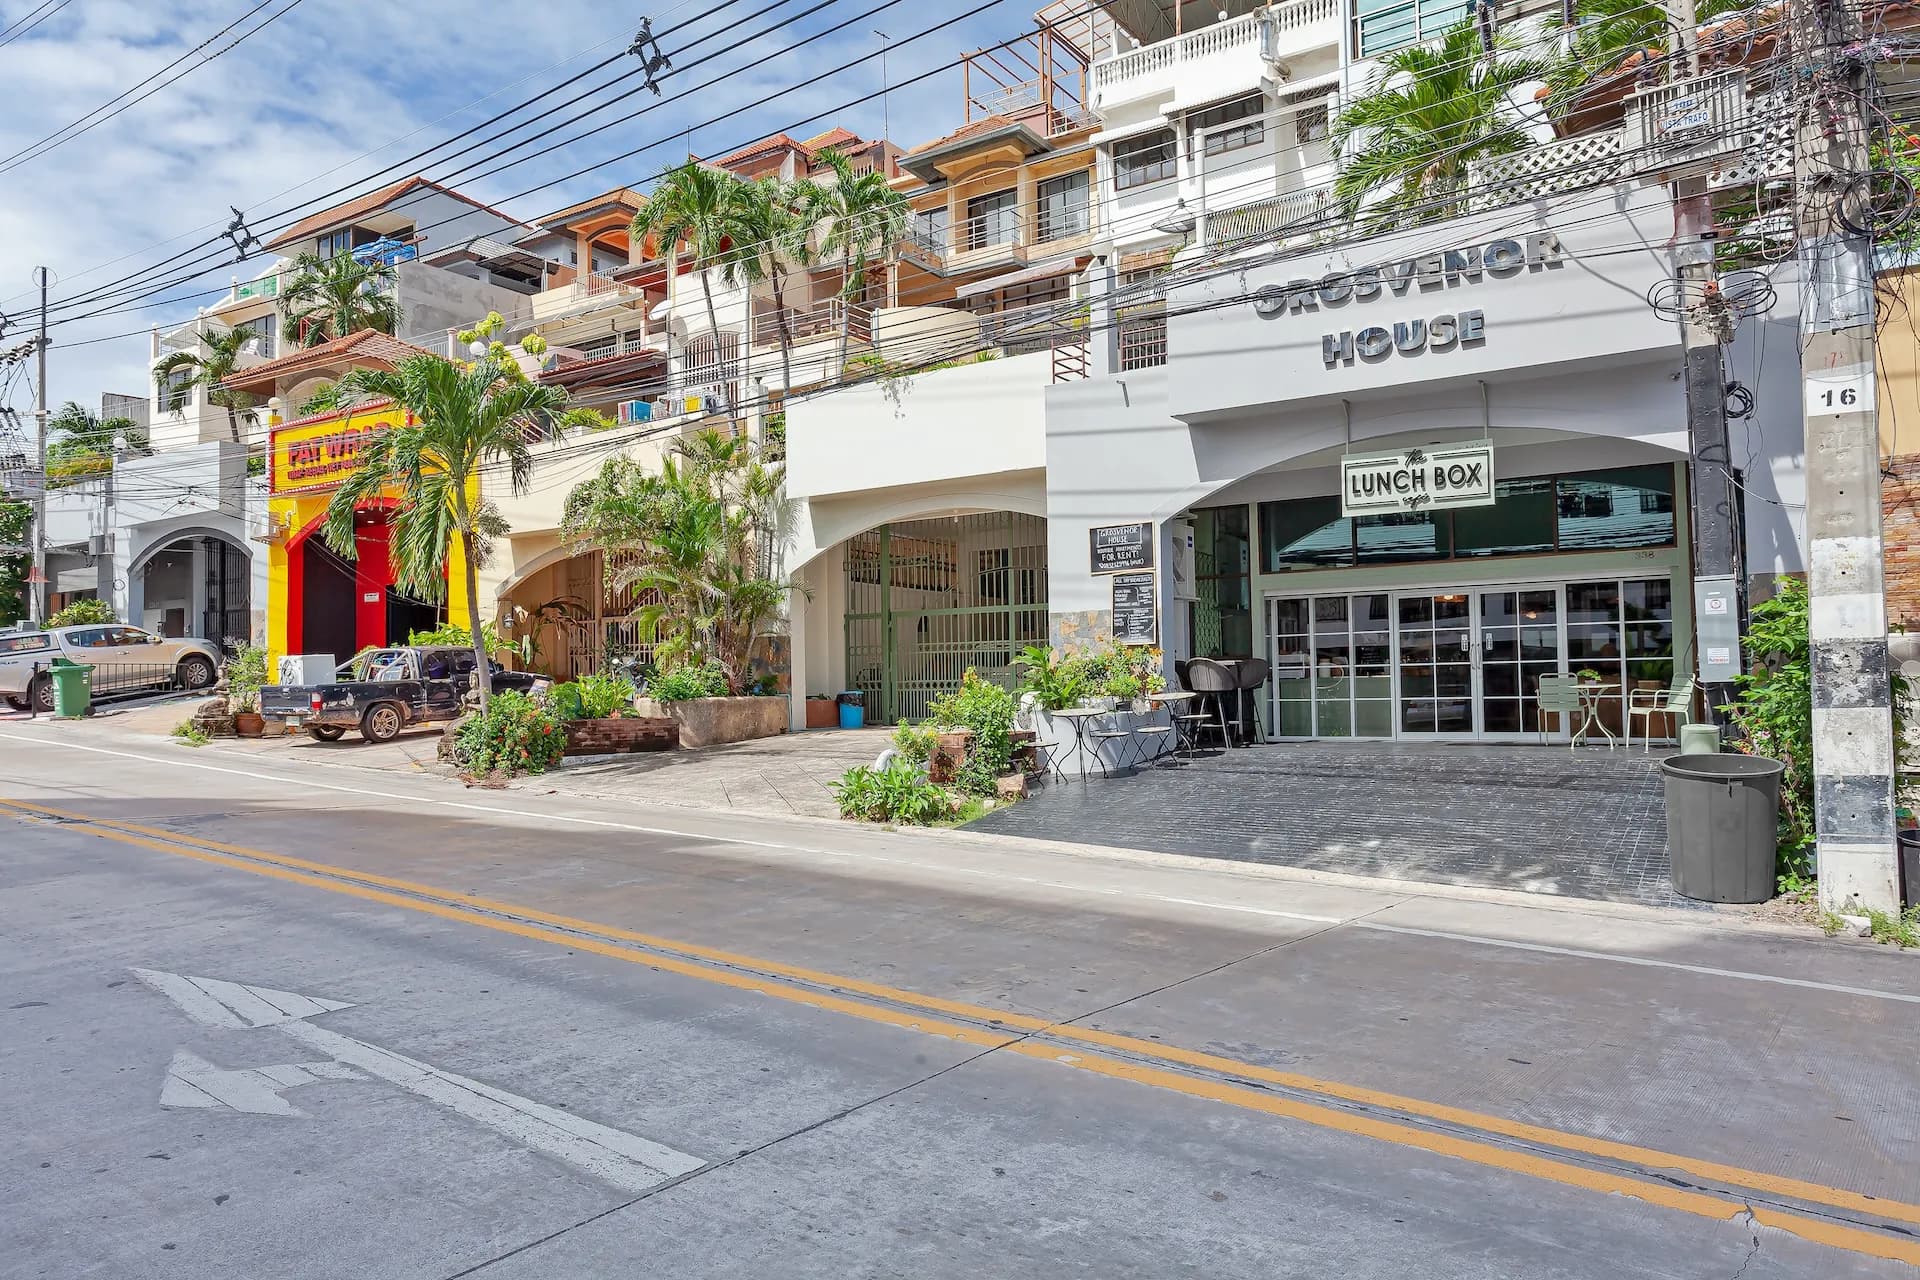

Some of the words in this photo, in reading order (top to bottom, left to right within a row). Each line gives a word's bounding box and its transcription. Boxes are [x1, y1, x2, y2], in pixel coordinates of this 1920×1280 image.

[1253, 233, 1563, 315] GROSVENOR
[1322, 309, 1486, 364] HOUSE
[1821, 388, 1857, 407] 16
[288, 435, 321, 466] FAT
[1405, 448, 1427, 468] The
[1352, 468, 1426, 495] LUNCH
[1434, 463, 1482, 488] BOX
[1108, 535, 1128, 544] HOUSE
[1101, 552, 1116, 562] FOR
[1117, 550, 1139, 560] RENT!
